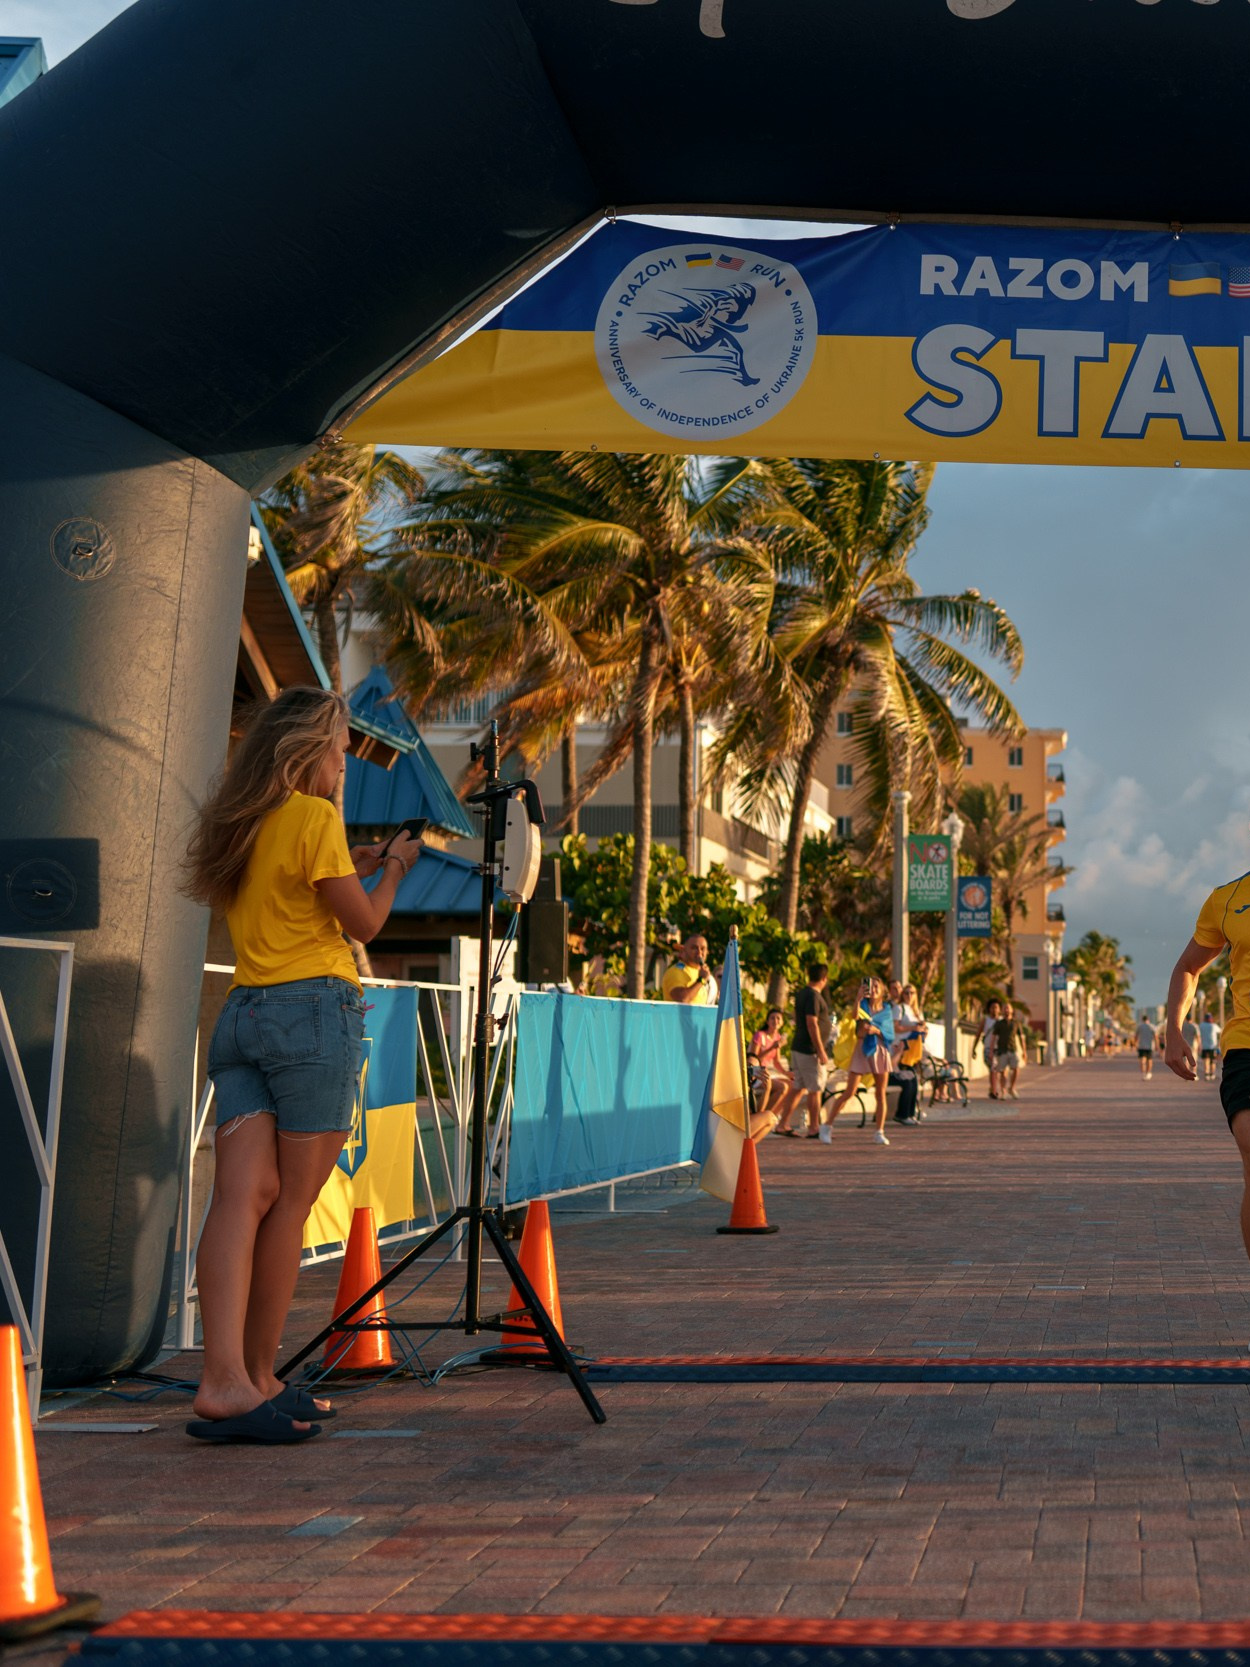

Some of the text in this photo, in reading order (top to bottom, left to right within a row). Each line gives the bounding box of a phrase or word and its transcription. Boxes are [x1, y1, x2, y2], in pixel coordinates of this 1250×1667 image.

[619, 257, 786, 307] RAZOM RUN
[919, 253, 1149, 302] RAZOM
[608, 300, 804, 427] ANNIVERSARY OF INDEPENDENCE OF UKRAINE 5K RUN
[910, 864, 948, 879] SKATE
[910, 880, 948, 890] BOARDS
[957, 921, 991, 929] LITTERING
